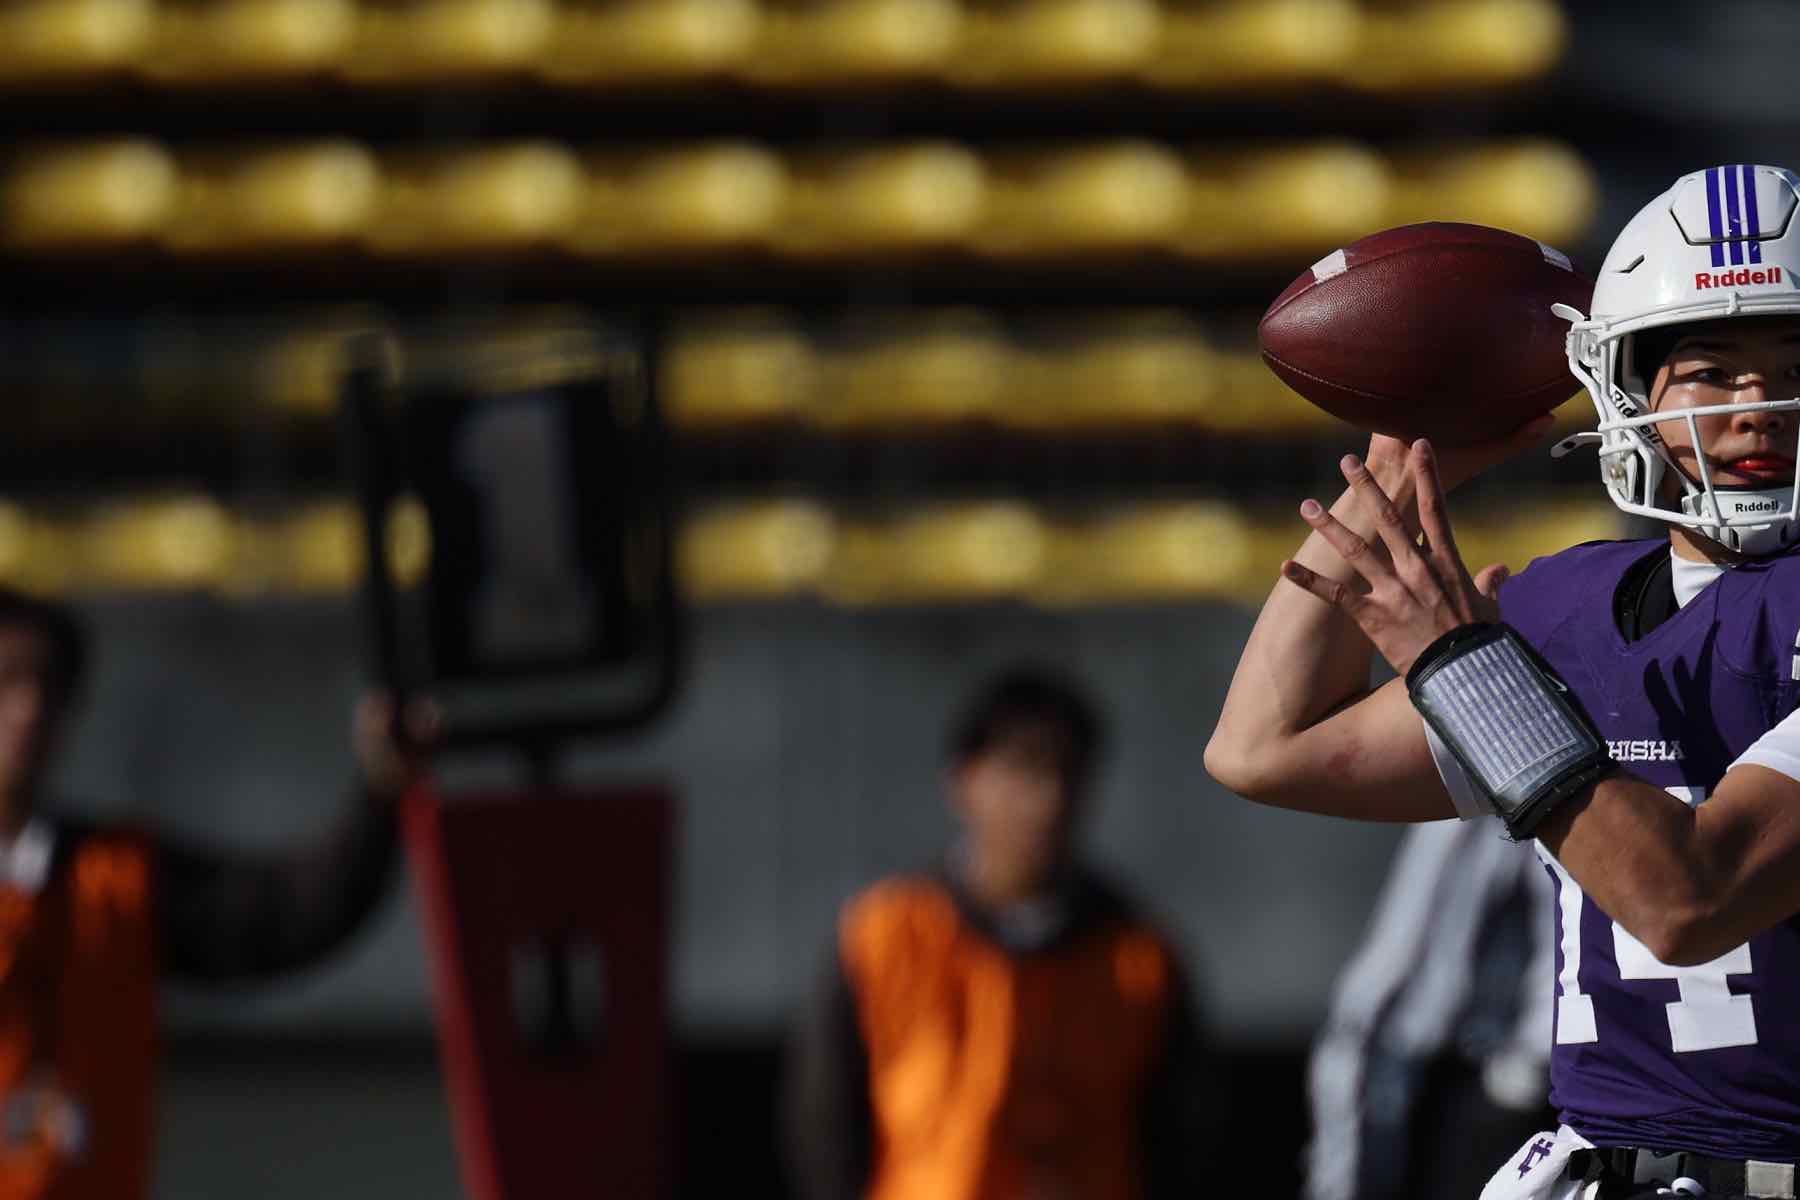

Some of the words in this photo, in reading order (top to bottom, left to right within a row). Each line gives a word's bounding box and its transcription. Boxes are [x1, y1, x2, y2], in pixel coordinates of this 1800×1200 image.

[1694, 267, 1782, 291] Riddell
[1614, 390, 1664, 444] Ridell
[1734, 499, 1780, 515] Riddell
[1605, 739, 1687, 762] HISHA
